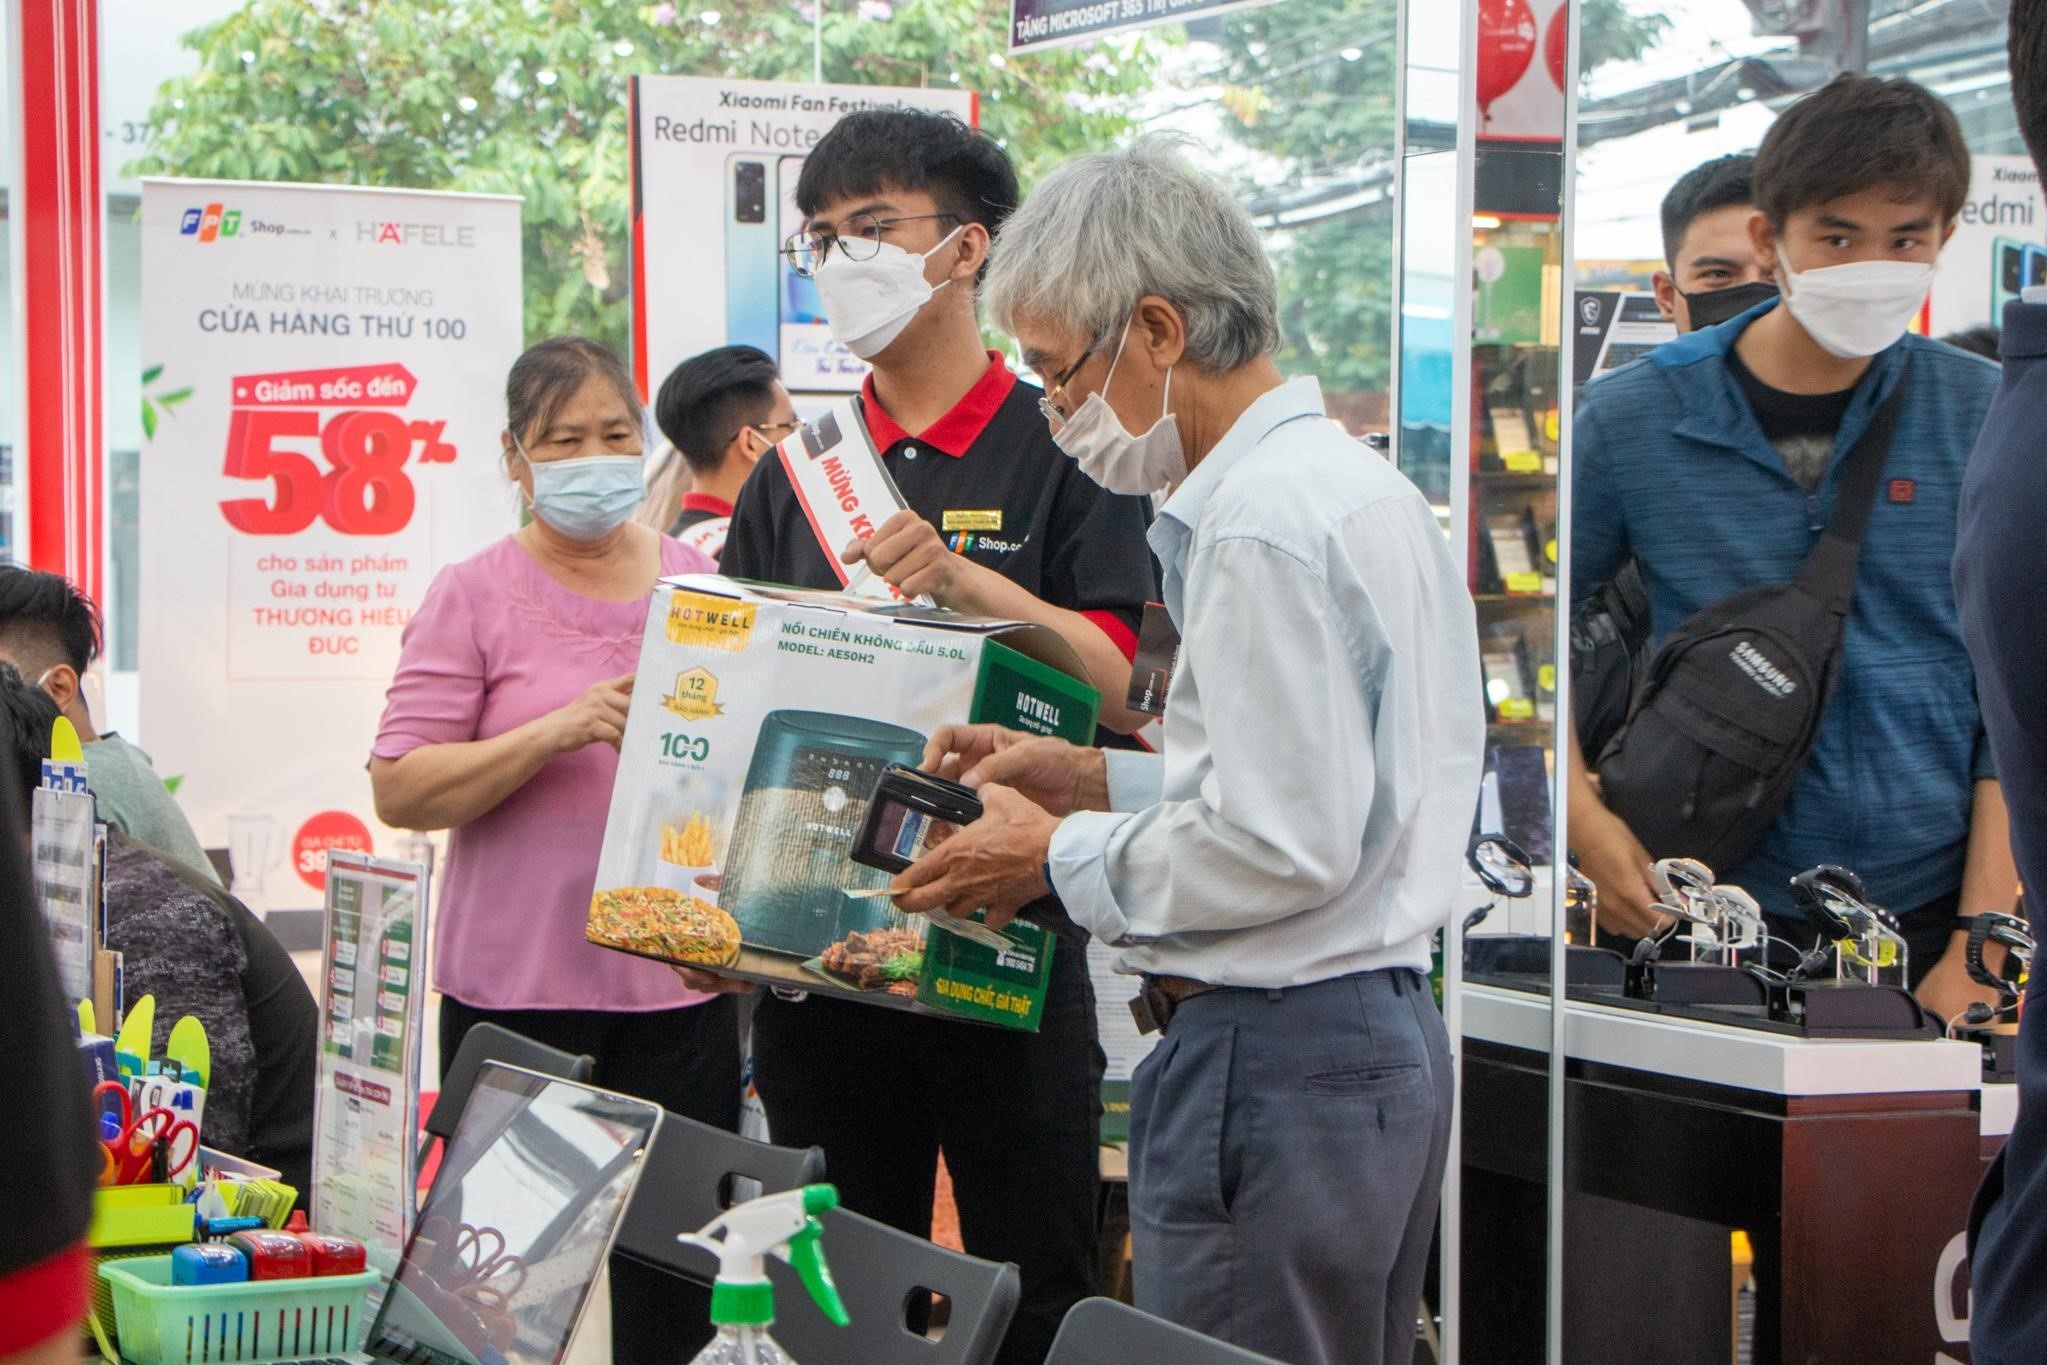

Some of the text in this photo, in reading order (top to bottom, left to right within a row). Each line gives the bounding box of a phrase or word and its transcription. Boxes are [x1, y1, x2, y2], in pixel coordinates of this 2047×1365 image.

[1016, 14, 1048, 43] TẶNG
[1049, 2, 1120, 32] MICROSOFT
[1120, 0, 1143, 18] 365
[718, 91, 787, 110] Xiaomi
[791, 95, 825, 112] Fan
[655, 116, 818, 148] Redmi Note
[181, 202, 242, 243] FPT
[1962, 194, 2034, 225] edmi
[300, 284, 347, 303] KHAI
[199, 301, 466, 340] CỬA HÀNG THỨ 100
[254, 374, 406, 402] Giảm sốc đến
[218, 409, 457, 536] 58%
[821, 456, 859, 513] MỪNG
[948, 530, 975, 554] FPT
[256, 552, 408, 576] cho sản phẩm
[270, 579, 307, 598] Gia
[314, 581, 370, 602] dụng
[253, 607, 352, 626] THƯƠNG
[671, 606, 750, 630] HOTWELL
[777, 640, 876, 665] MODEL: AE50H2
[781, 620, 806, 636] NỒI
[853, 631, 903, 650] KHÔNG
[937, 646, 967, 661] 5.0L
[1735, 641, 1798, 694] SAMSUNG
[681, 690, 708, 704] tháng
[688, 677, 705, 690] 12
[1015, 691, 1060, 727] HOTWELL
[660, 732, 710, 762] 100
